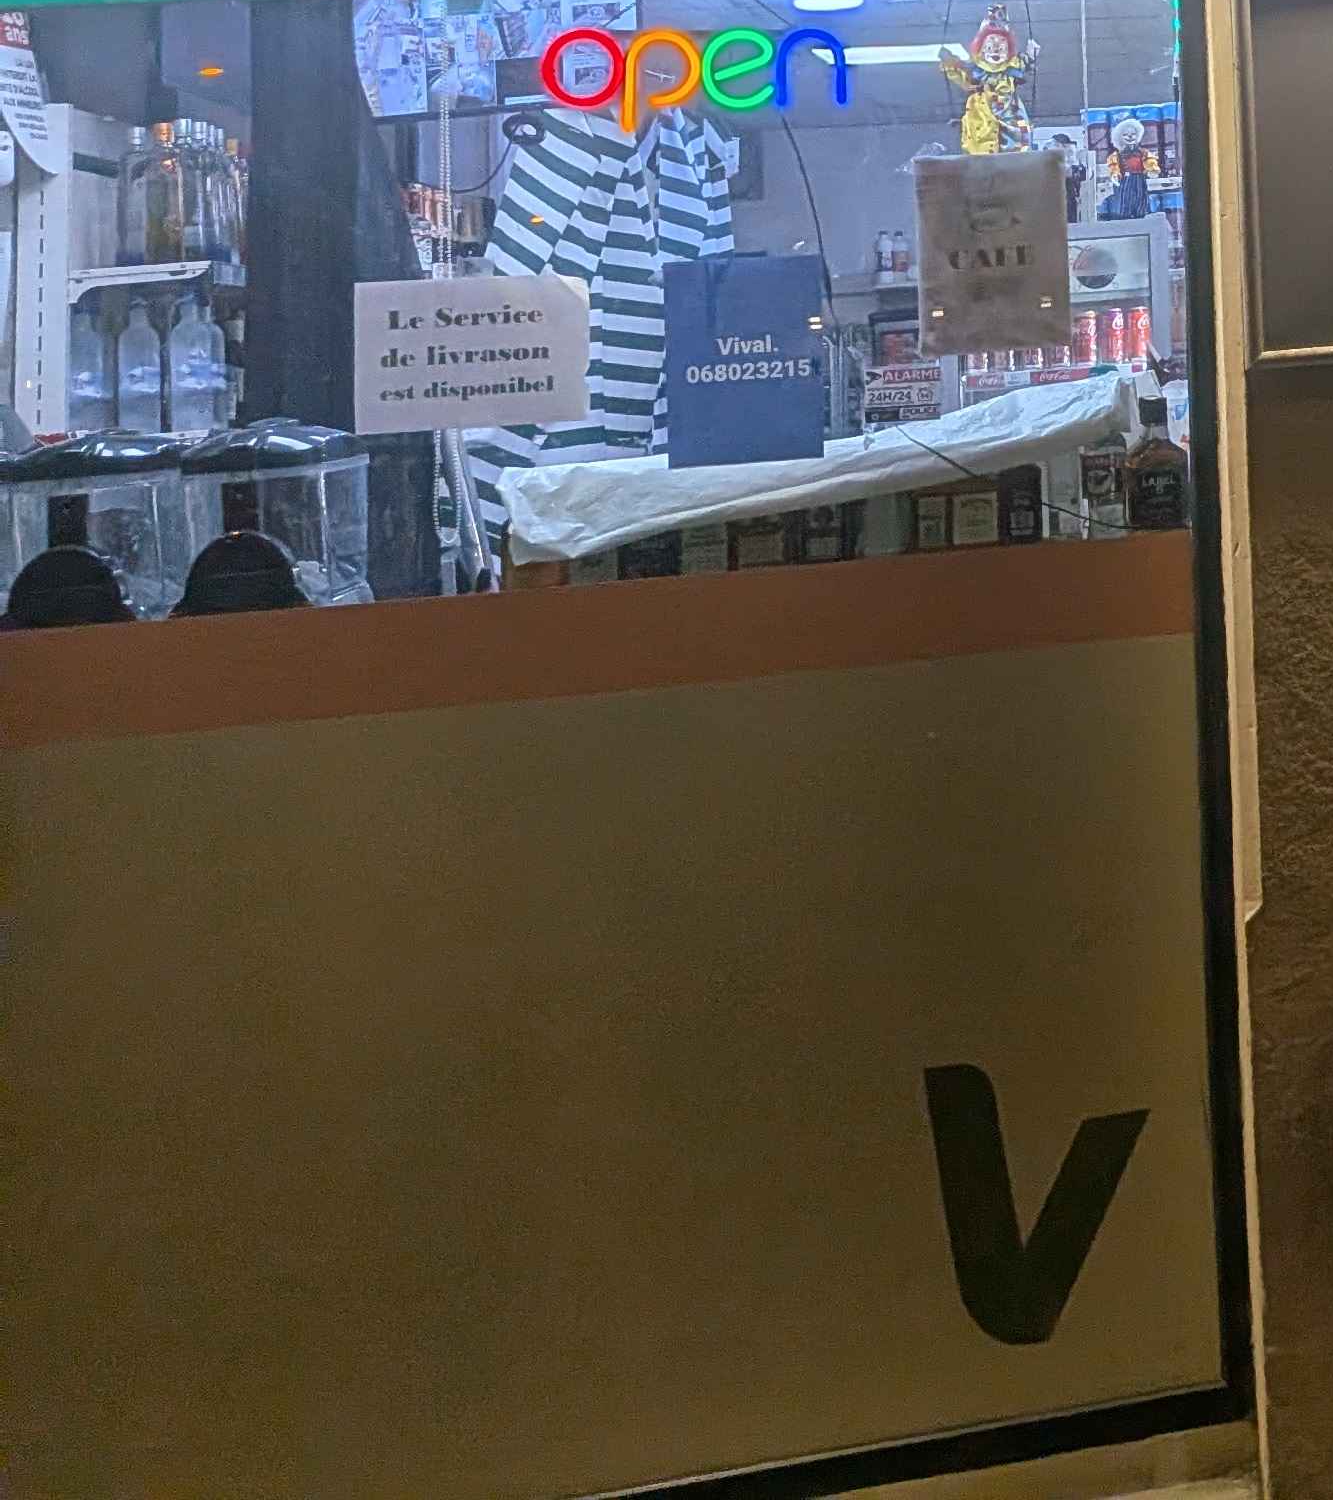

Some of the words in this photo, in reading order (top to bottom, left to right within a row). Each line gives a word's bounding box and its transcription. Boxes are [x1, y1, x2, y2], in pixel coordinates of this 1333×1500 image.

[540, 27, 848, 132] open
[388, 309, 424, 330] Le
[435, 304, 544, 329] Service
[380, 347, 416, 368] de
[426, 344, 550, 367] livrason
[717, 334, 779, 356] Vival.
[685, 358, 811, 384] 068023215
[379, 383, 415, 401] est
[423, 374, 555, 401] disponibel
